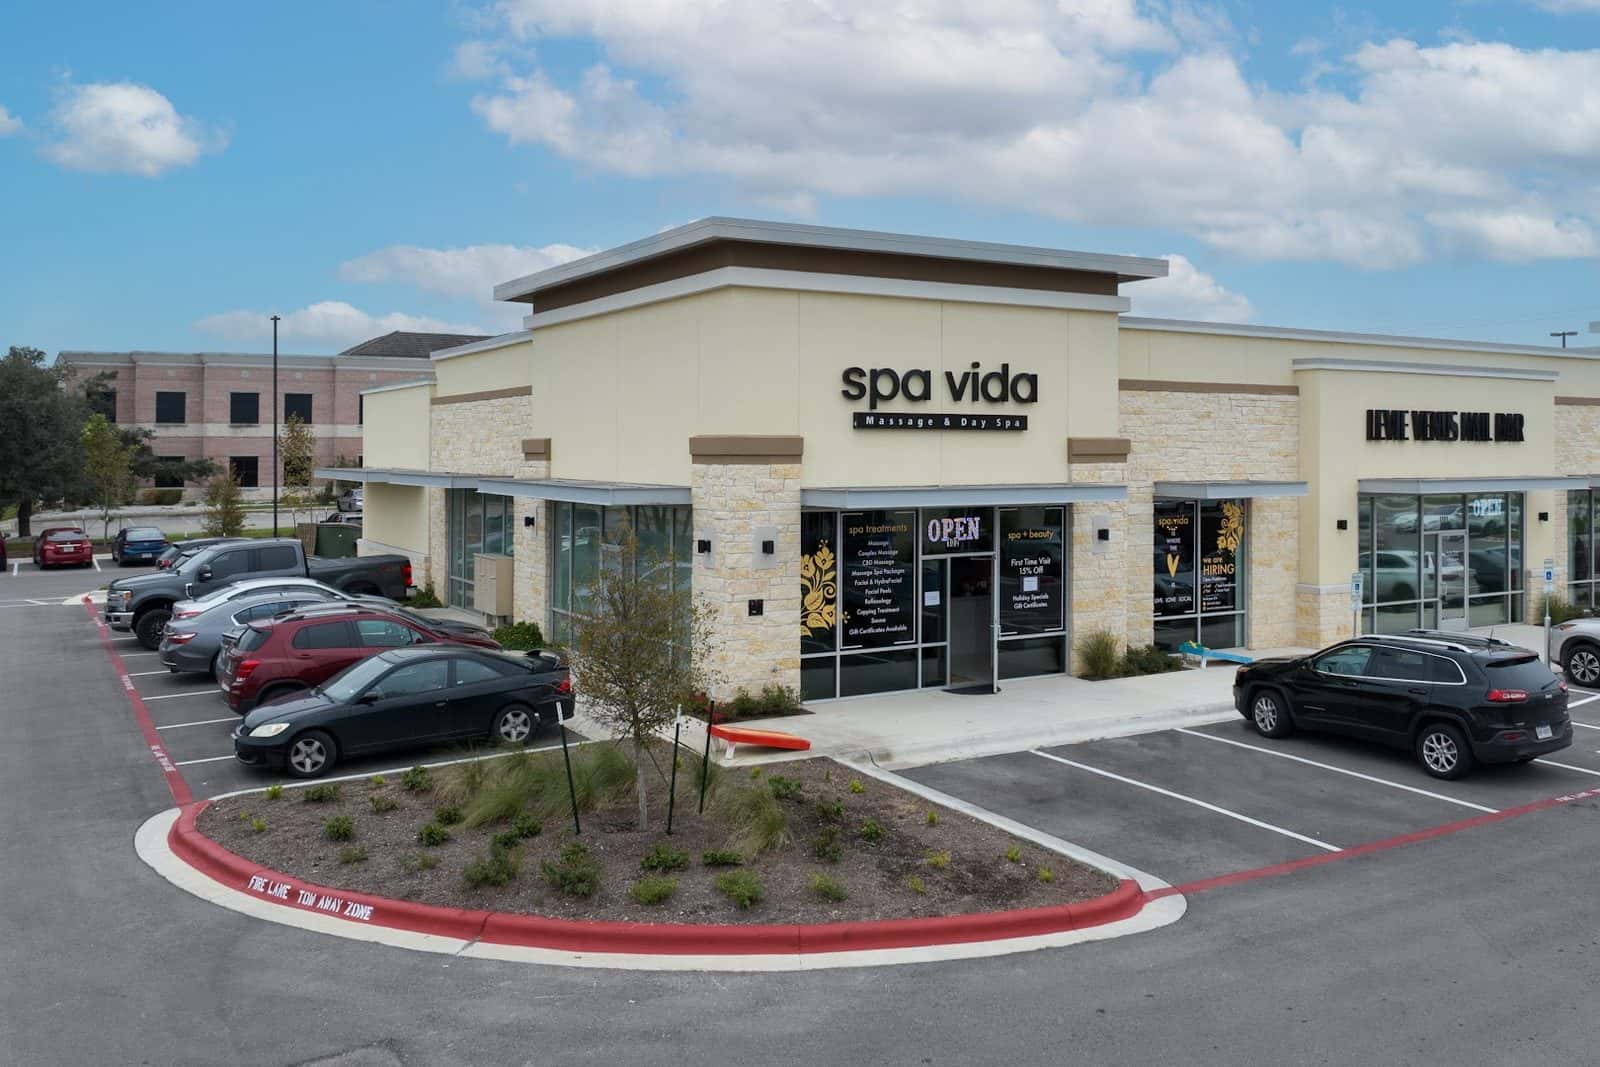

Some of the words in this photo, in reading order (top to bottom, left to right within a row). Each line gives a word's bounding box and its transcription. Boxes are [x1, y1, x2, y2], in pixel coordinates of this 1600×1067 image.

[841, 366, 931, 410] spa
[944, 362, 1038, 404] vida
[866, 416, 934, 428] Massage
[944, 417, 950, 426] &
[961, 418, 986, 429] Day
[996, 418, 1020, 429] Spa
[1460, 412, 1493, 441] NAIL
[1495, 413, 1524, 442] BAR
[1473, 499, 1502, 516] OPEN
[848, 526, 864, 537] spa
[866, 523, 908, 534] treatments
[927, 516, 980, 542] OPEN
[1008, 531, 1021, 541] spa
[1029, 527, 1055, 540] beauty
[1011, 558, 1023, 567] First
[1024, 557, 1038, 566] Time
[1039, 557, 1051, 565] Visit
[1020, 567, 1032, 575] 15%
[1033, 566, 1044, 574] Off
[1203, 563, 1234, 577] HIRING
[248, 875, 268, 892] FIRE
[268, 880, 292, 899] LANE
[297, 890, 317, 907] TOW
[317, 895, 344, 913] AWAY
[344, 901, 374, 921] ZONE
